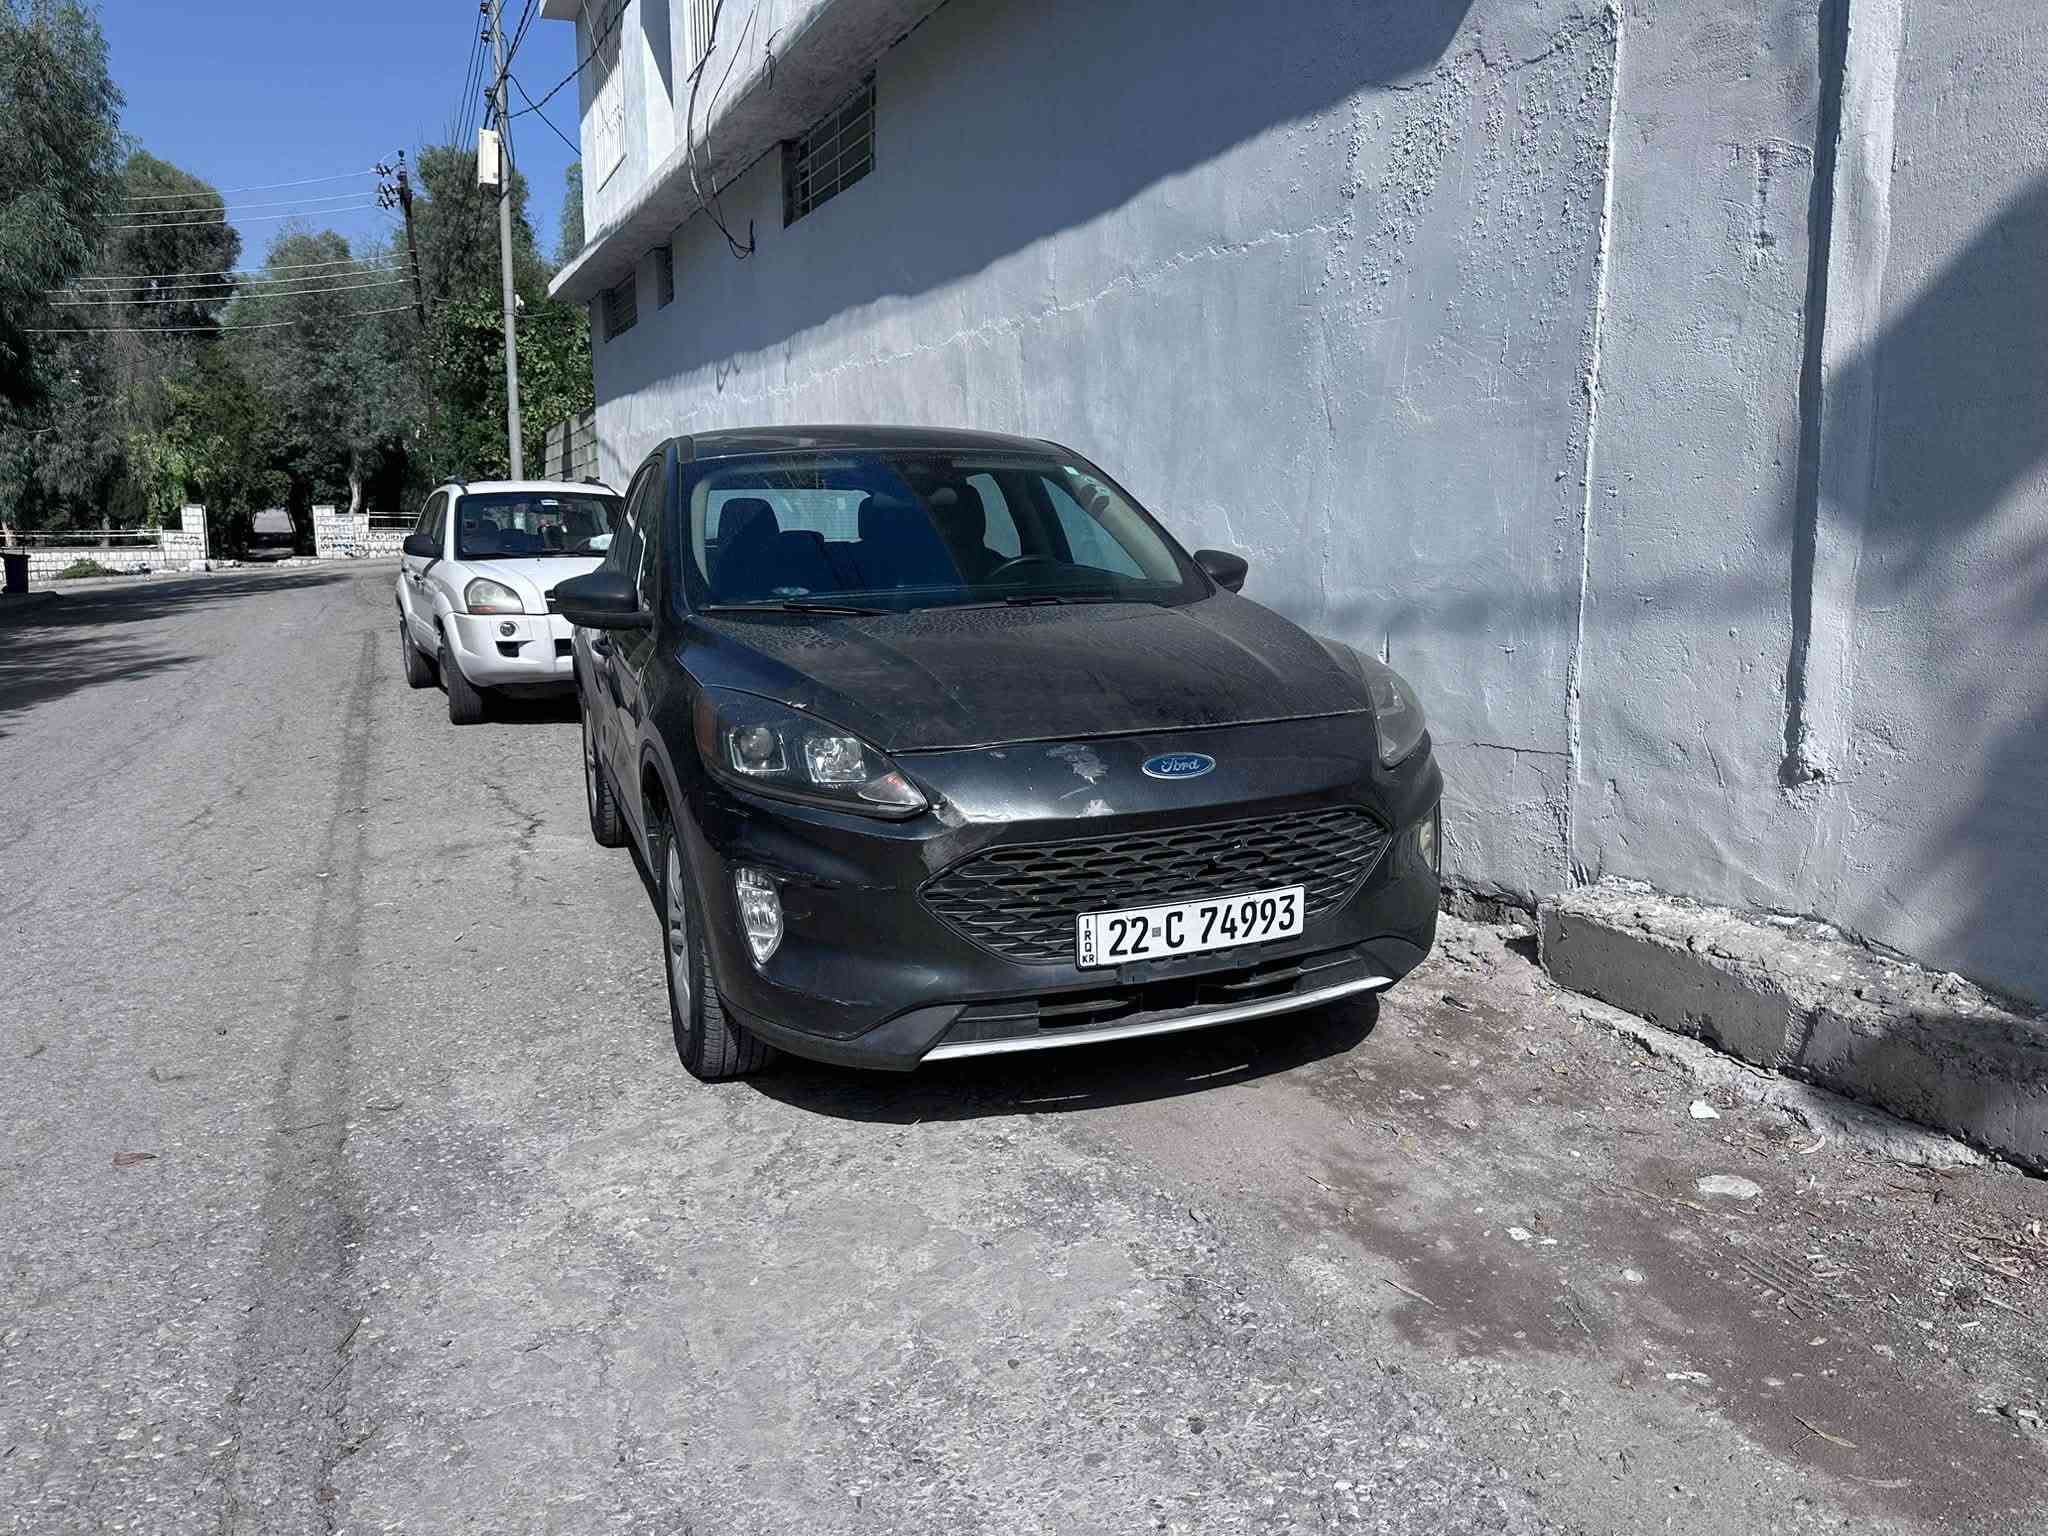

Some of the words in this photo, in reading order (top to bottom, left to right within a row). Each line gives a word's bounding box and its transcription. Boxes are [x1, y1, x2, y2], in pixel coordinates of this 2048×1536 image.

[1161, 757, 1200, 773] Ford
[1108, 916, 1150, 957] 22
[1166, 910, 1184, 948] C
[1200, 894, 1295, 944] 74993
